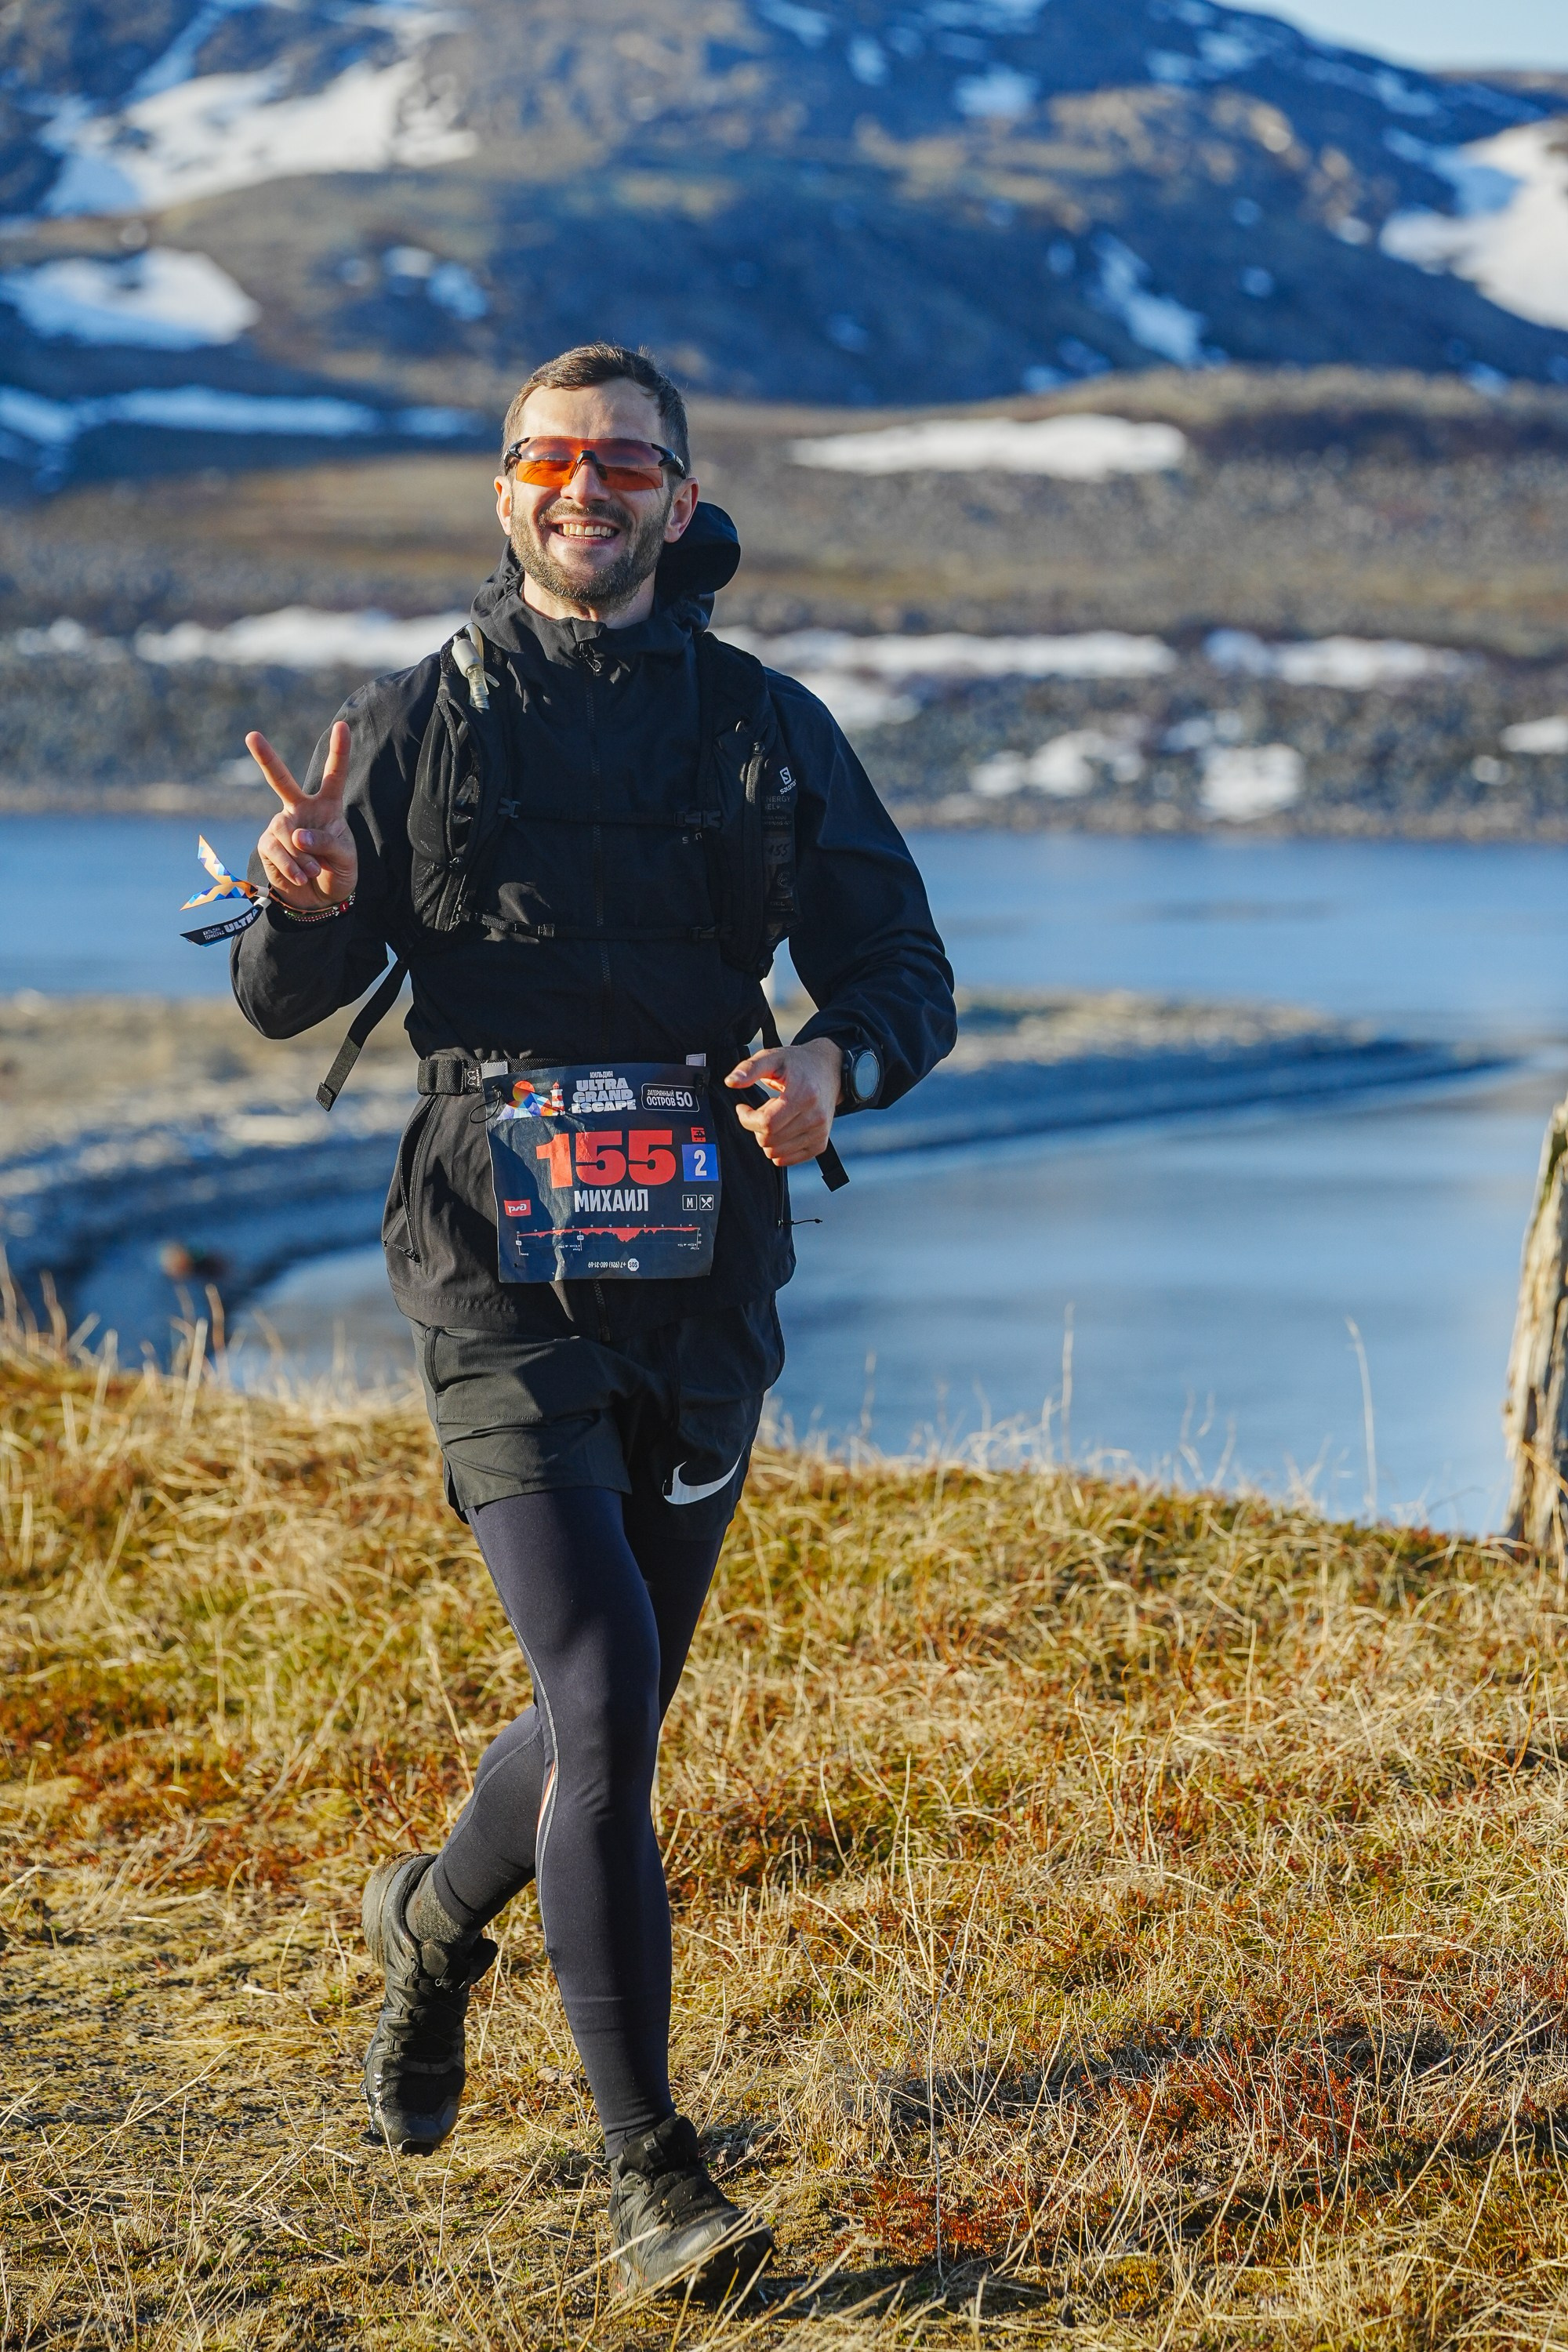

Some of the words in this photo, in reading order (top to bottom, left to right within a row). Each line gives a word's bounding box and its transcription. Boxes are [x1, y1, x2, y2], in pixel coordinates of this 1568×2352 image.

[768, 843, 789, 857] 155
[223, 908, 259, 933] ULTRA
[590, 1070, 614, 1079] КИЛЬДИН
[575, 1077, 630, 1091] ULTRA
[572, 1089, 633, 1102] GRAND
[646, 1095, 676, 1107] ОСТРОВ
[675, 1091, 693, 1108] 50
[571, 1099, 637, 1114] ESCAPE
[535, 1130, 677, 1189] 155
[694, 1149, 707, 1176] 2
[573, 1189, 649, 1213] МИХАИЛ
